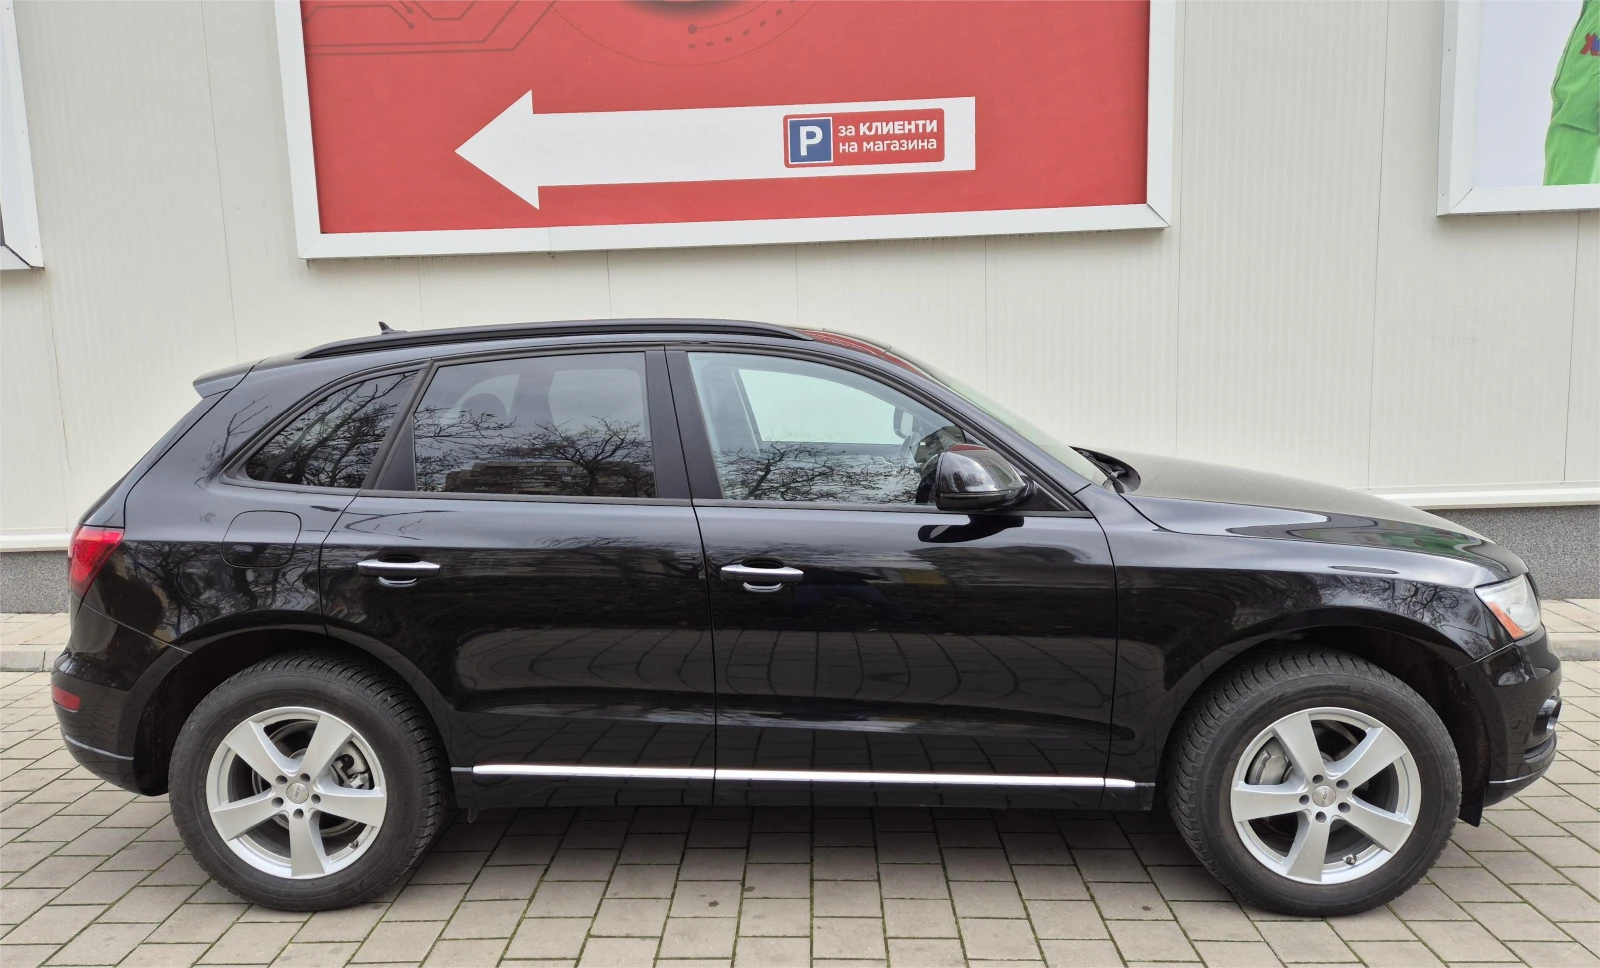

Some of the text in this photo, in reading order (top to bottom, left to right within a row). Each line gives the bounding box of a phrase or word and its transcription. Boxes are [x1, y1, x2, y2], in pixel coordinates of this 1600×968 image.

[838, 119, 938, 136] за КЛИЕНТИ
[800, 125, 823, 156] P
[839, 138, 937, 153] на магазина
